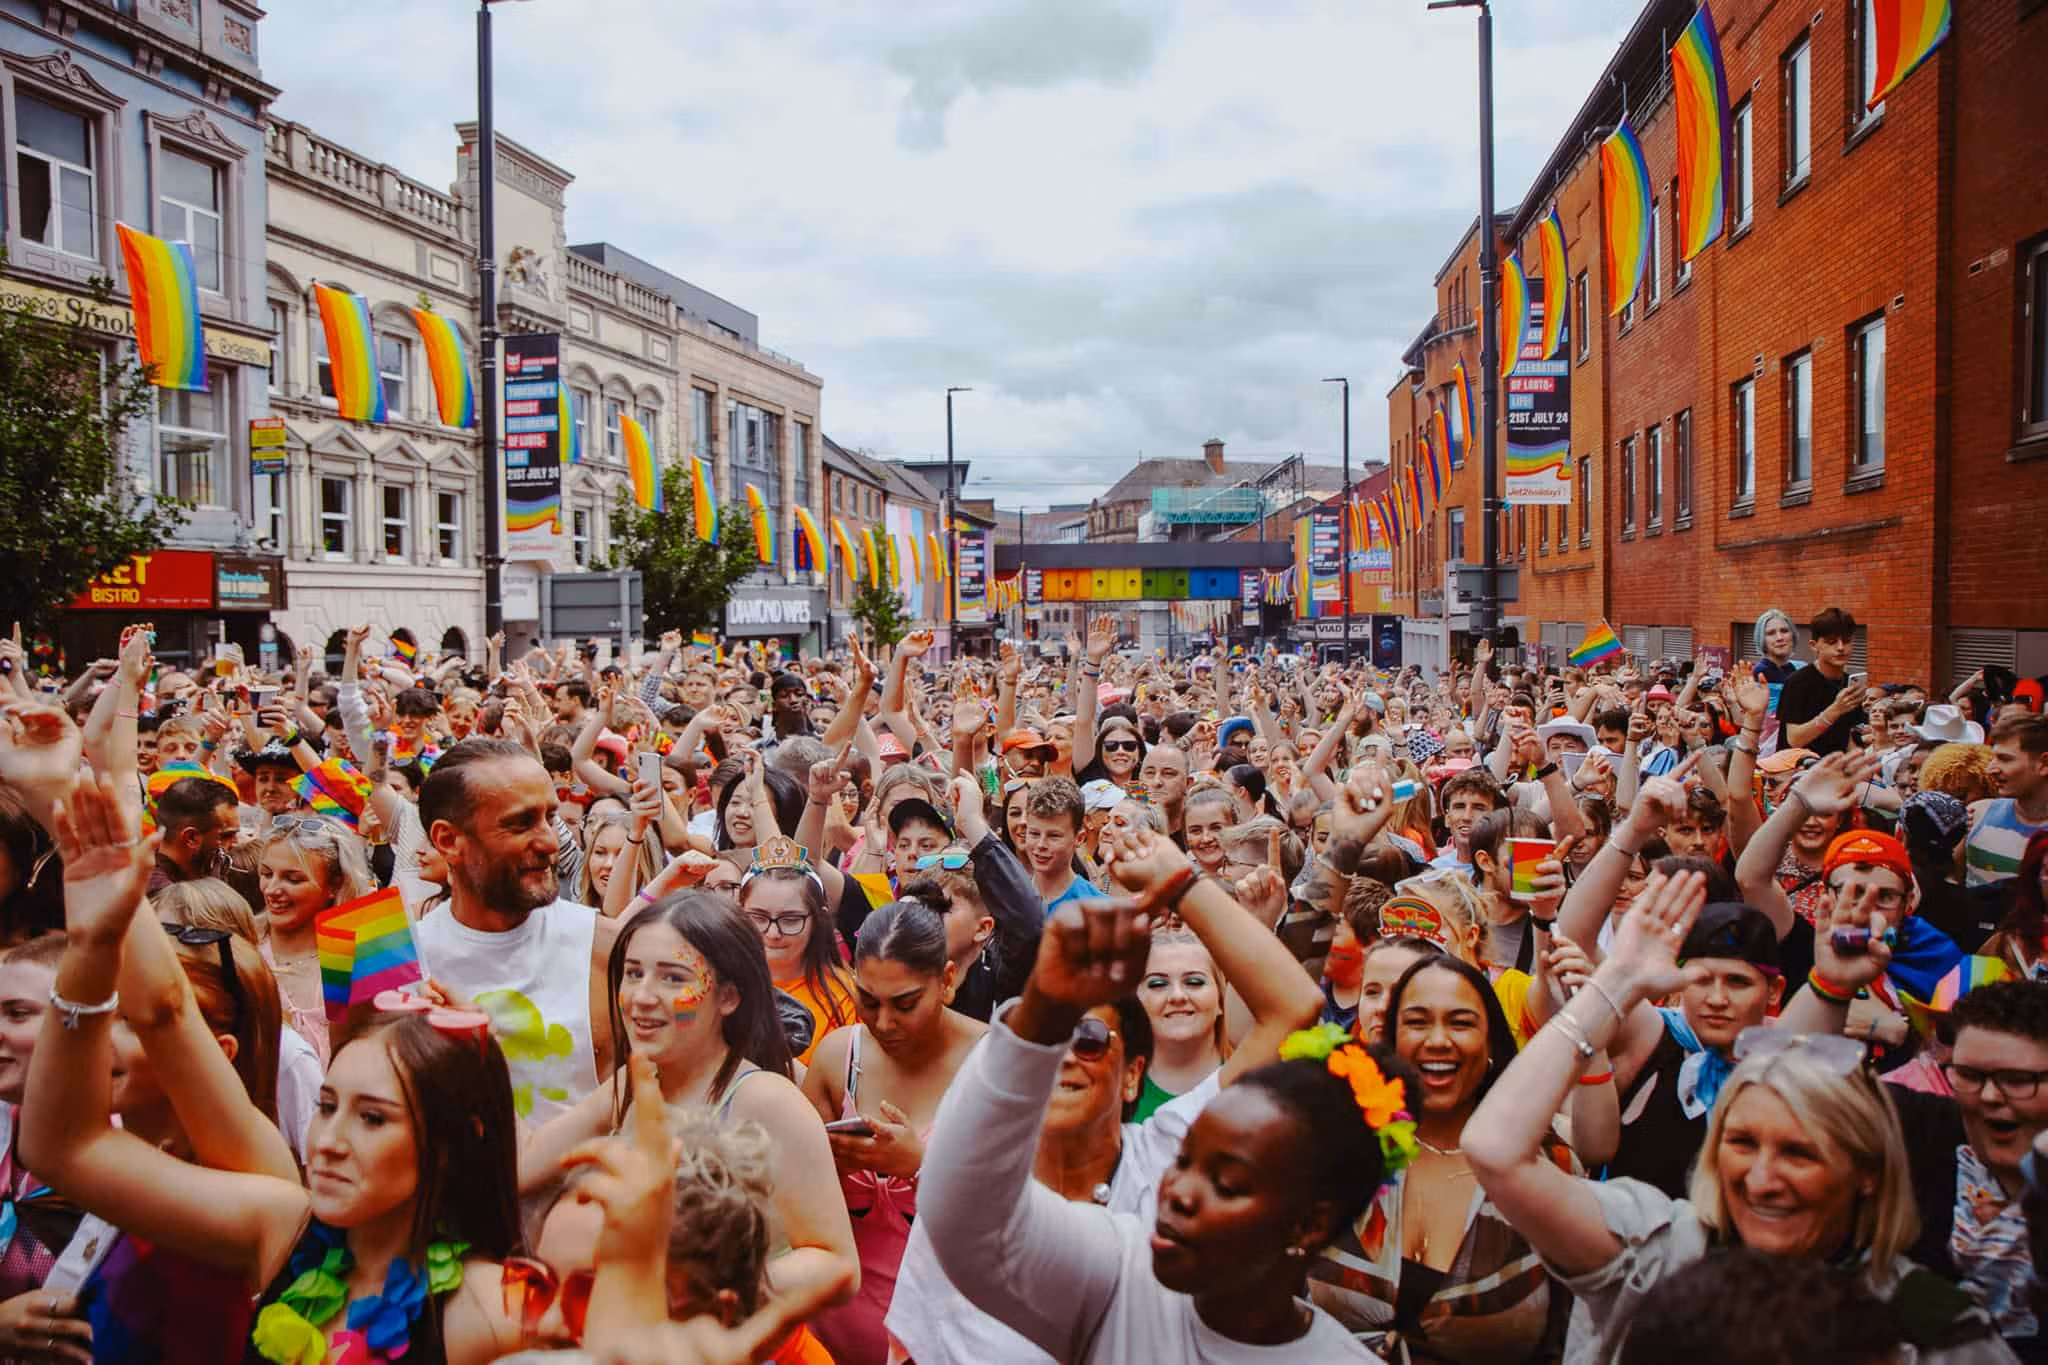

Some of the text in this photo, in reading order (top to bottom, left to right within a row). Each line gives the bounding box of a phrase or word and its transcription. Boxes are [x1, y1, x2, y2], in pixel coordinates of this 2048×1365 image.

[1509, 411, 1569, 424] 21ST JULY 24
[91, 588, 140, 603] BISTRO
[1318, 624, 1366, 633] VIADCT
